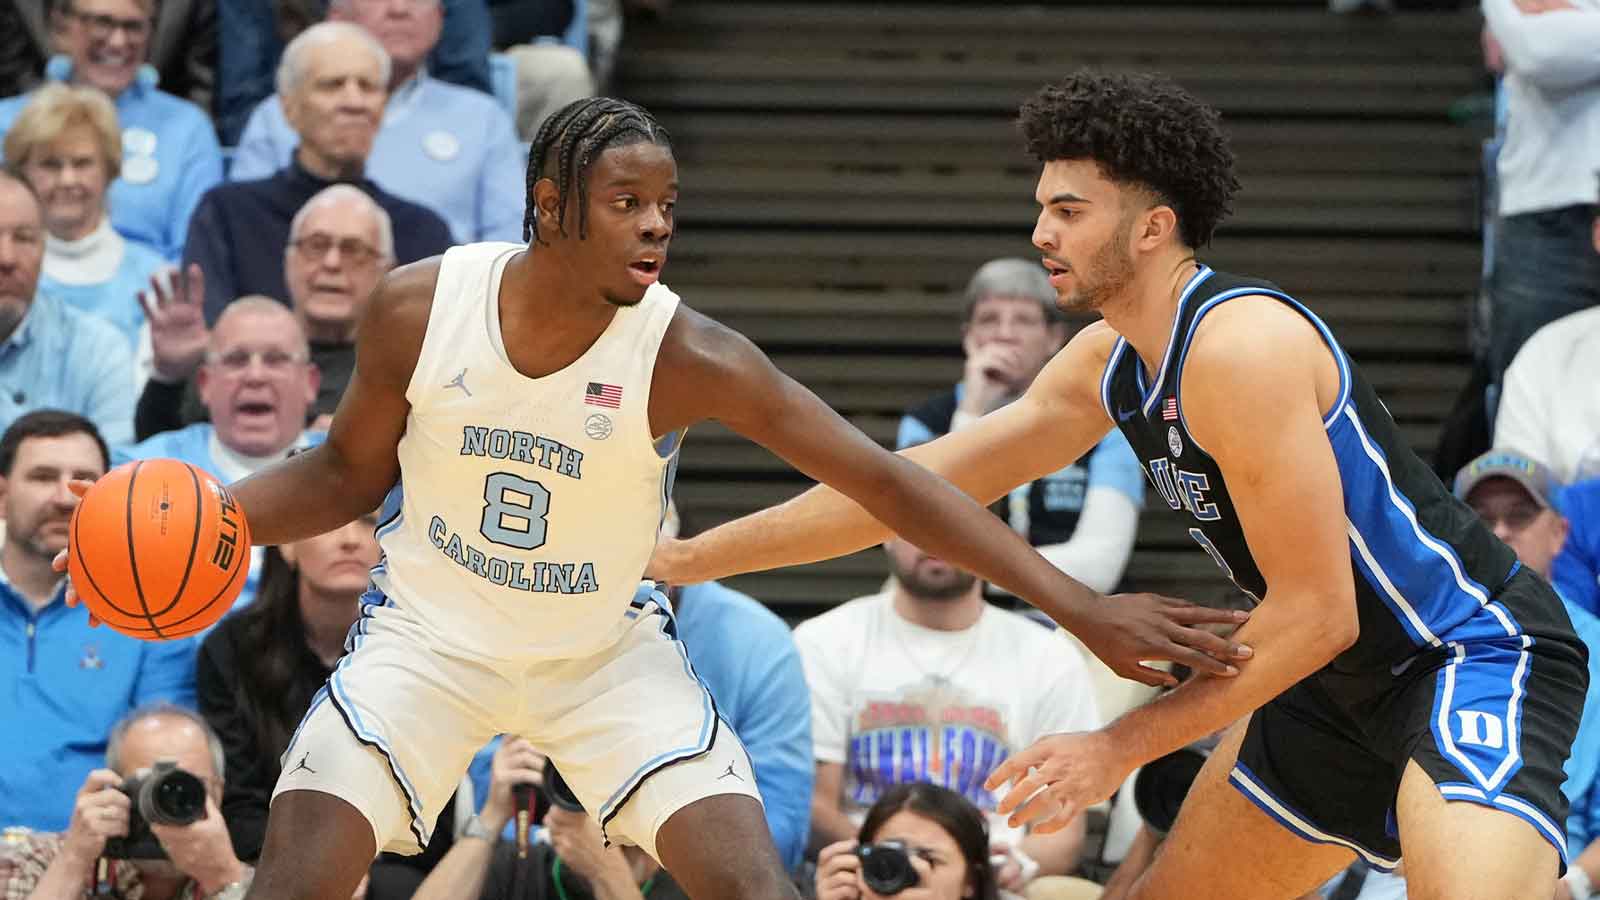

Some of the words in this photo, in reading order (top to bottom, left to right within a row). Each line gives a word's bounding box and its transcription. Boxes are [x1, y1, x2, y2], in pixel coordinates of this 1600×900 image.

[460, 425, 584, 479] NORTH
[212, 482, 238, 572] ELITE
[480, 471, 551, 551] 8
[428, 515, 599, 594] CAROLINA
[1455, 710, 1504, 749] D
